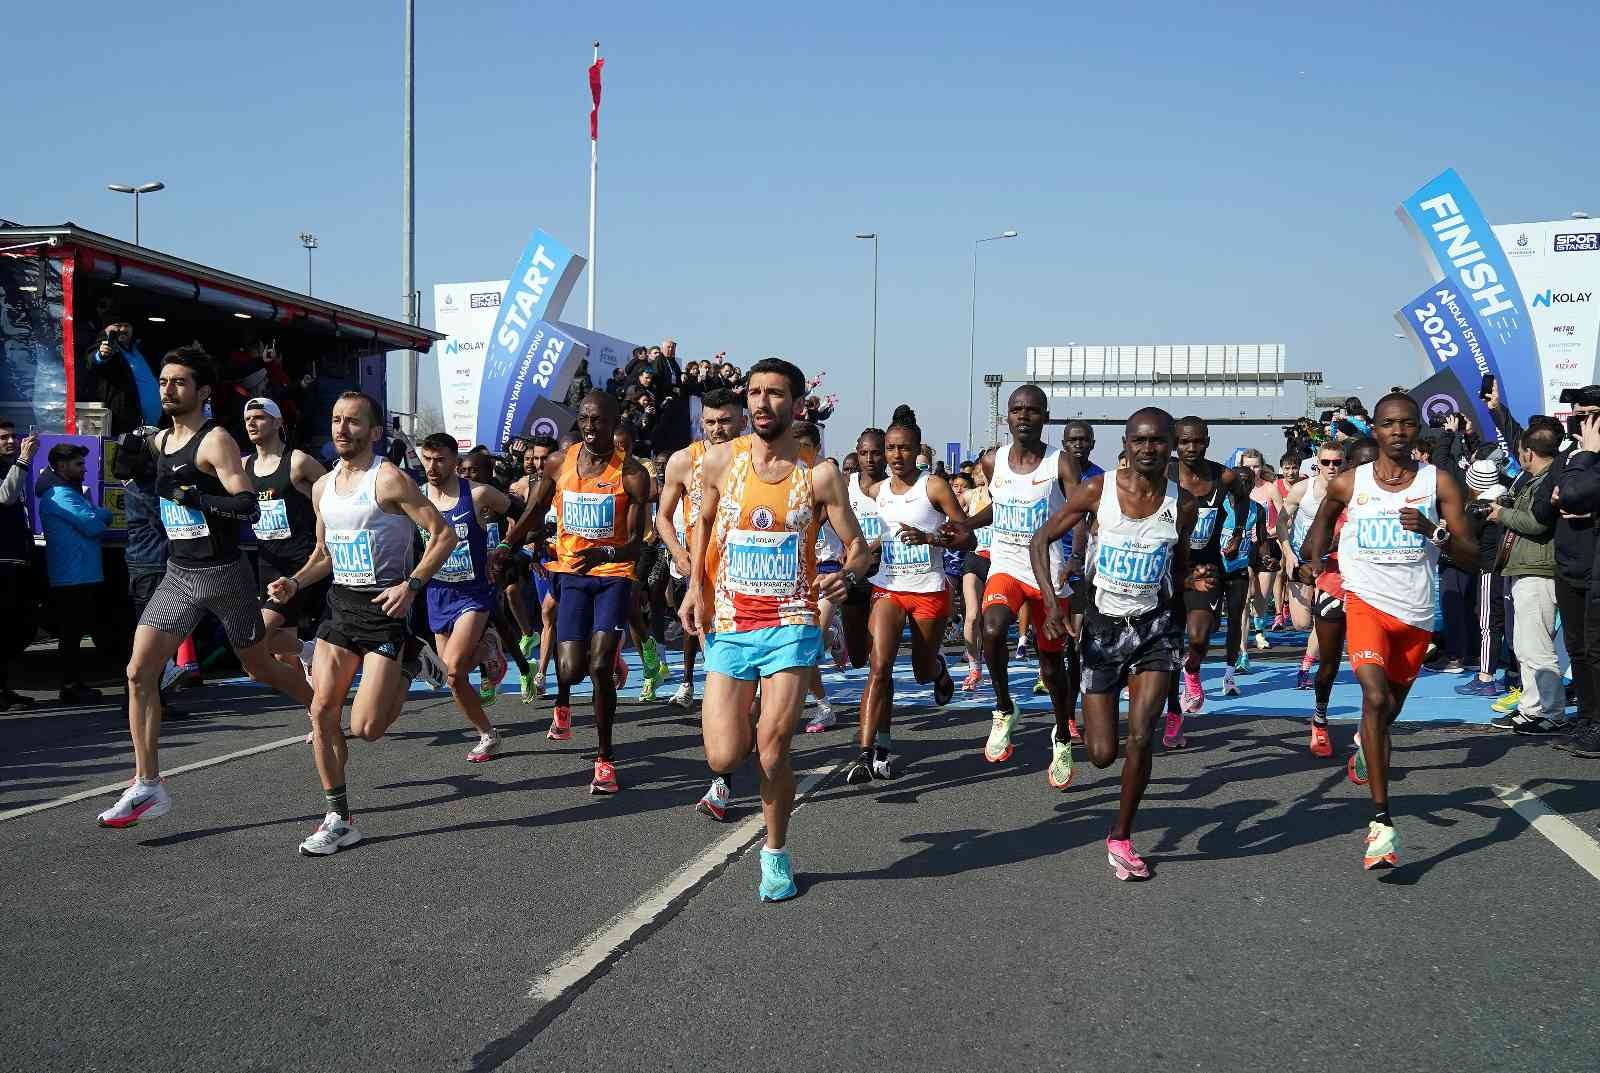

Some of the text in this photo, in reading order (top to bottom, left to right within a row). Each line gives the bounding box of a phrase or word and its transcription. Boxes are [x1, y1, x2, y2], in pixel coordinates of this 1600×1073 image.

[1420, 192, 1515, 318] FINISH
[1557, 234, 1598, 244] SPOR
[499, 244, 556, 353] START
[1414, 302, 1458, 362] 2022
[511, 379, 522, 401] YARI
[520, 329, 544, 381] MARATONU
[532, 337, 565, 389] 2022
[565, 502, 599, 528] BRIAN
[1103, 546, 1162, 582] VESTUS
